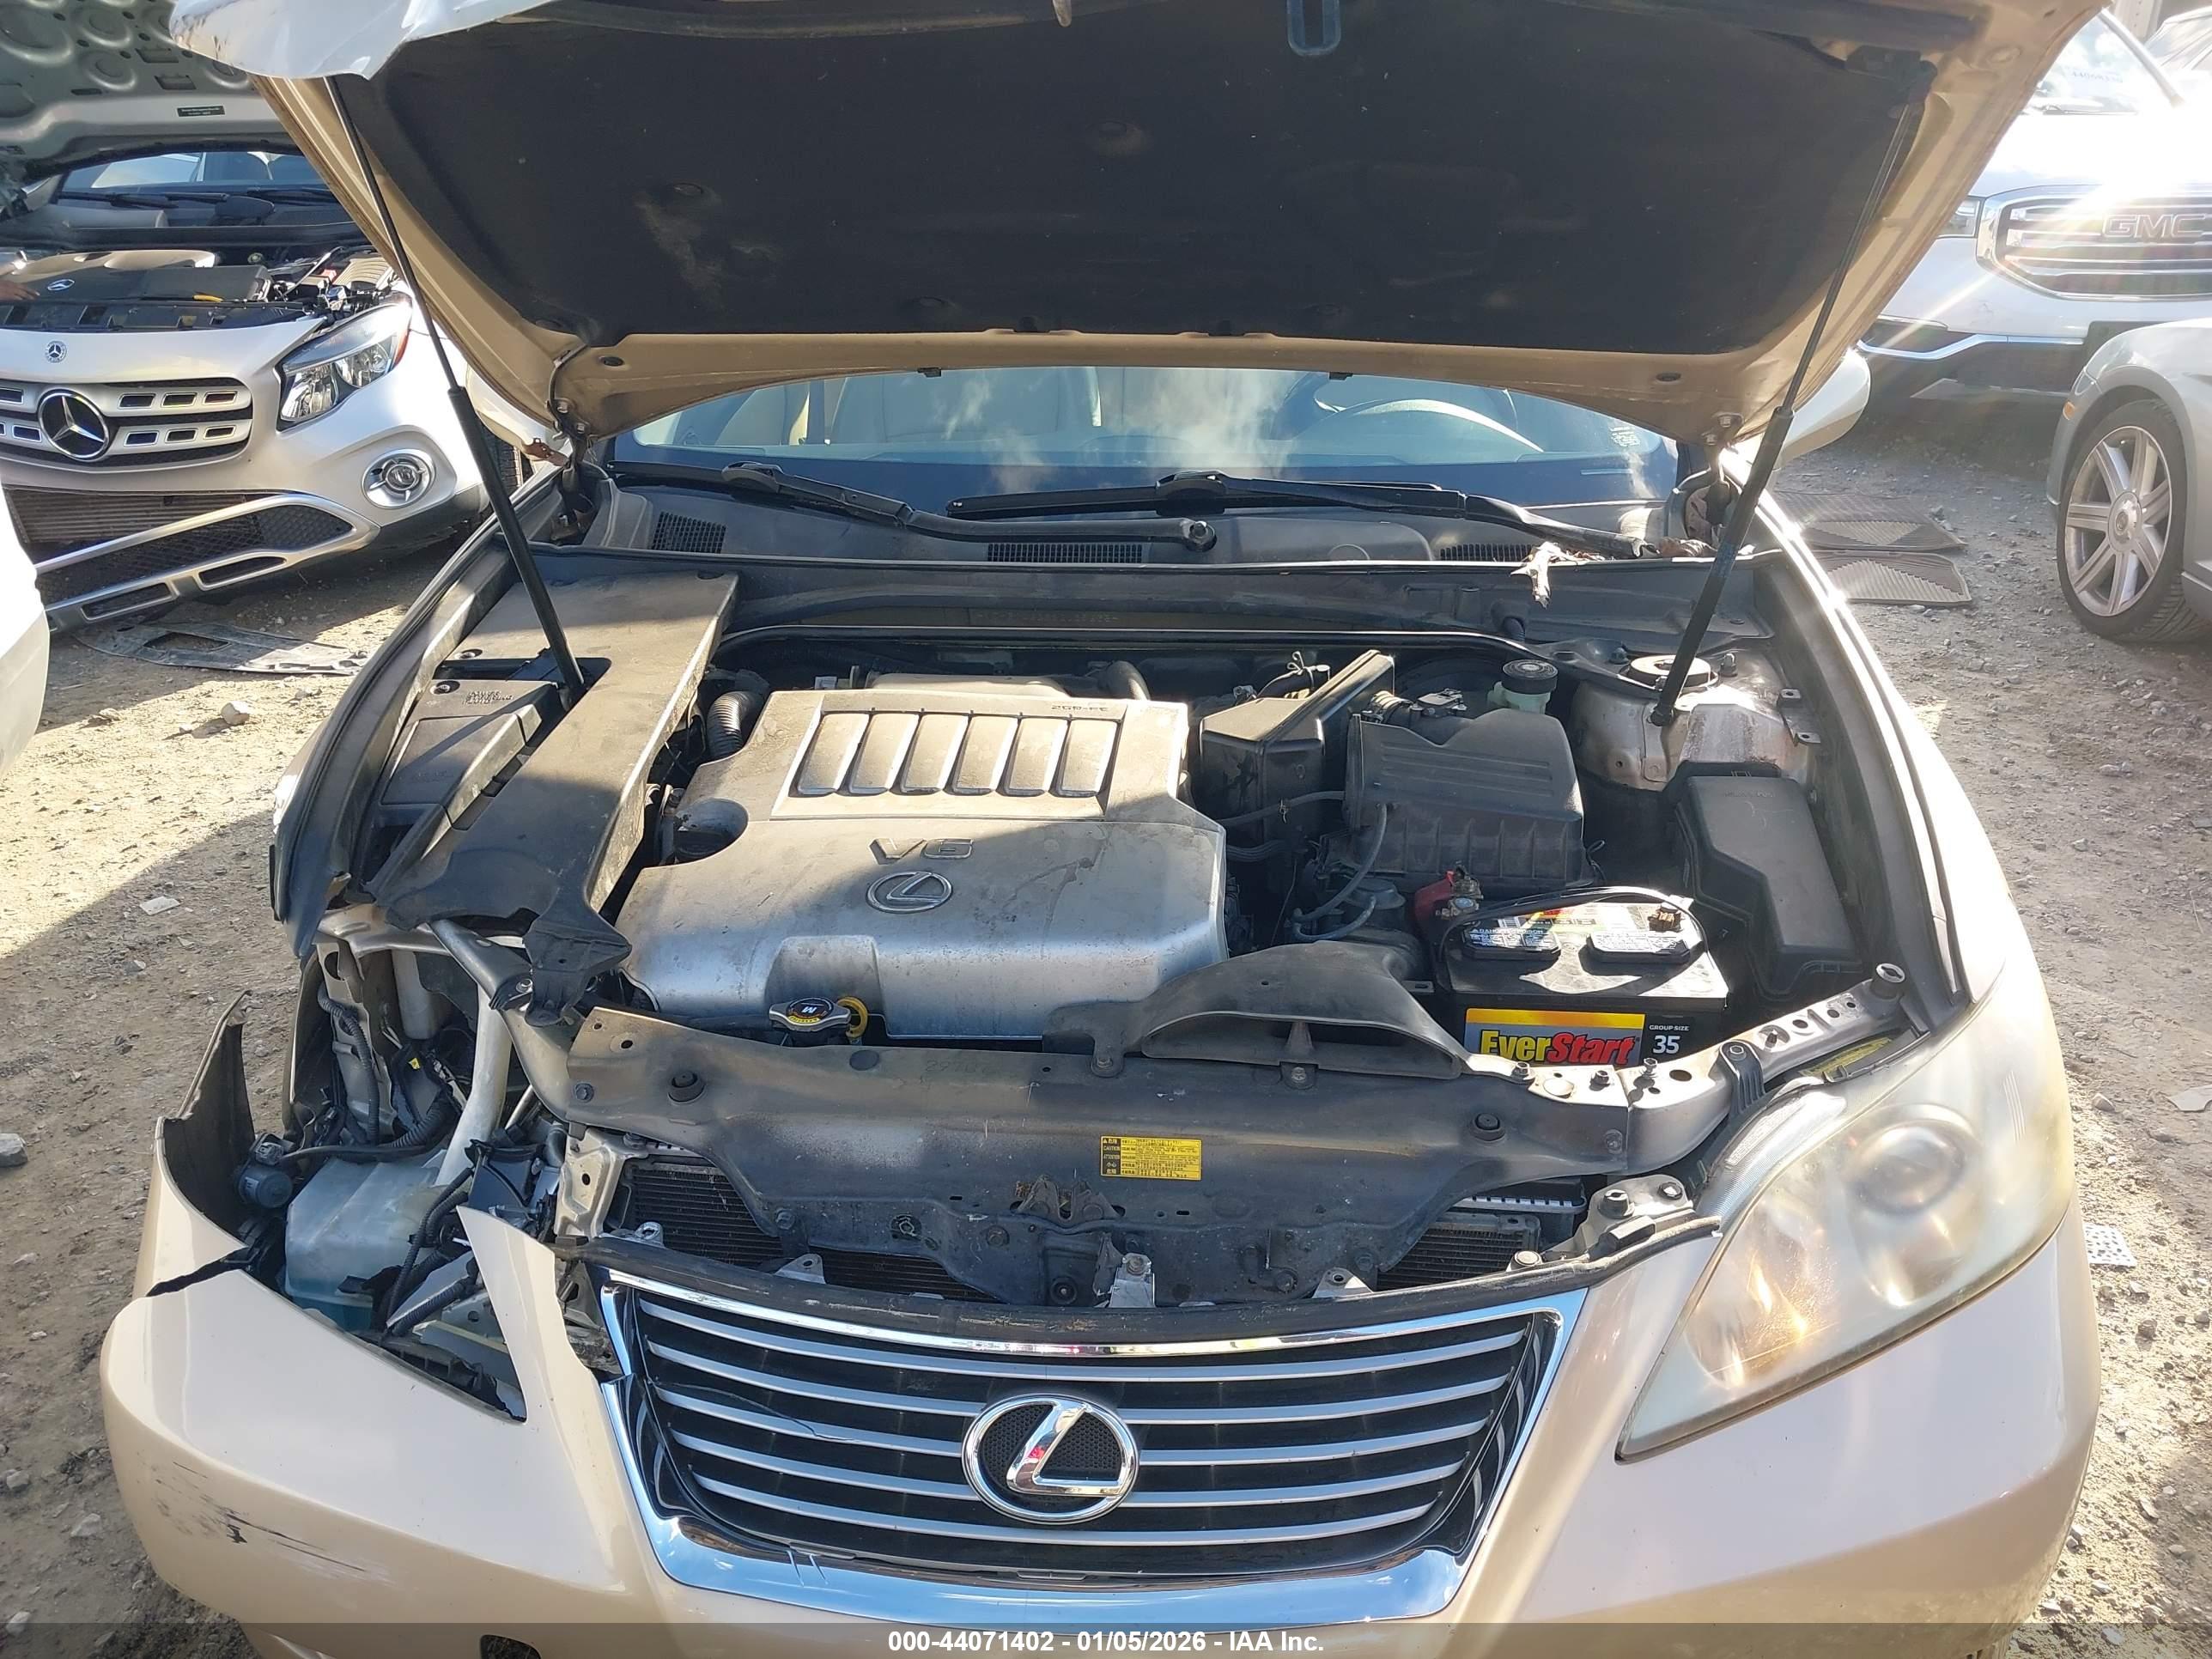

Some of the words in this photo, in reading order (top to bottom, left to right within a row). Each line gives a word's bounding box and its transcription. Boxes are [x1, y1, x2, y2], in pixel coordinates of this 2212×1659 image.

[2103, 214, 2206, 238] GMC
[867, 837, 975, 865] V6
[1480, 1030, 1636, 1065] EverStart
[1652, 1035, 1681, 1054] 35
